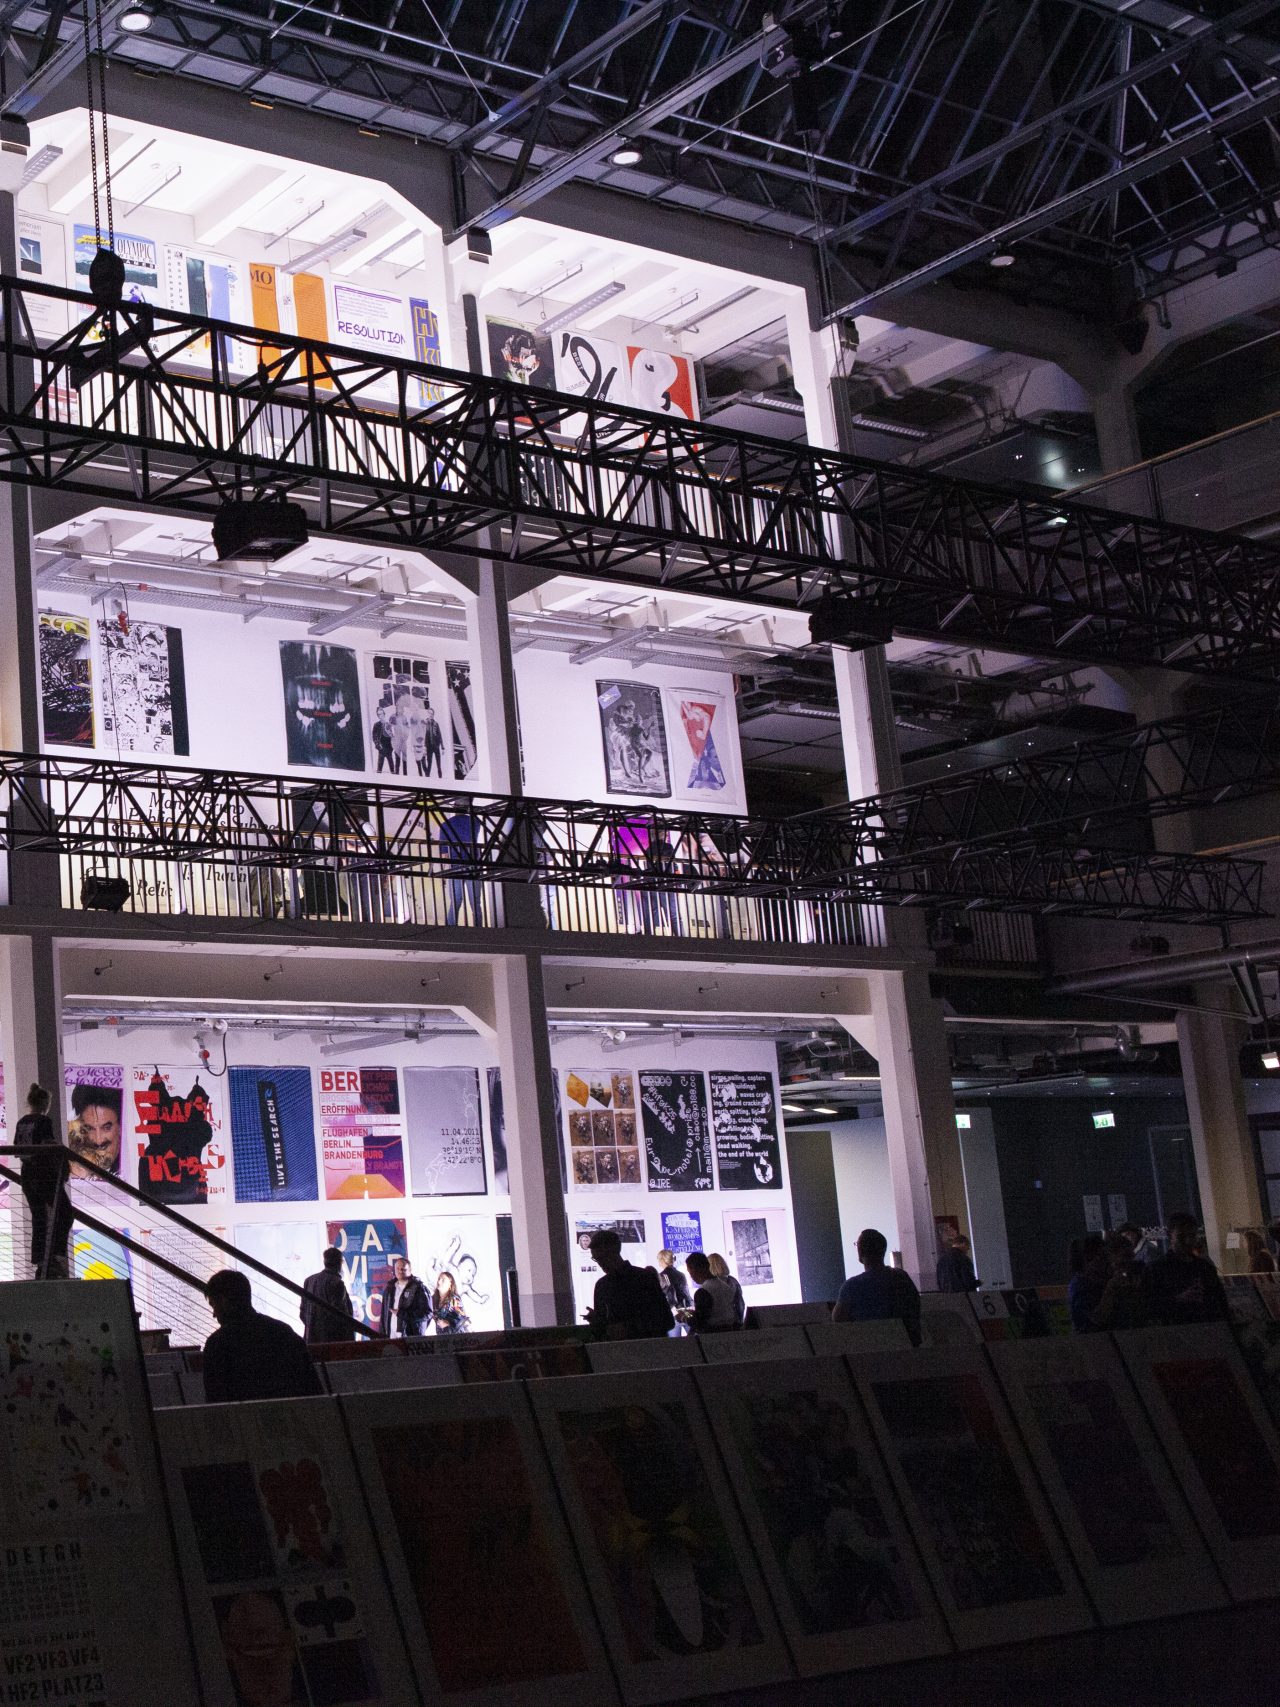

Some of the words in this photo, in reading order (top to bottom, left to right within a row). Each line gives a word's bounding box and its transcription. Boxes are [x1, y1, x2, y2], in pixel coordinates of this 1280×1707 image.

[117, 239, 152, 260] OLYMPIC
[320, 1071, 360, 1092] BER
[321, 1102, 369, 1114] ERÖFFNUNG
[266, 1100, 280, 1139] SEARCH
[322, 1128, 369, 1137] FLUGHAFEN
[716, 1134, 740, 1142] growing,
[273, 1141, 282, 1160] THE
[324, 1140, 352, 1149] BERLIN
[731, 1142, 752, 1150] walking,
[324, 1150, 384, 1160] BRANDENBURG
[276, 1163, 286, 1186] LIVE
[4, 1654, 36, 1675] VF2
[36, 1650, 68, 1671] VF3
[70, 1646, 101, 1667] VF4
[8, 1682, 40, 1701] HF2
